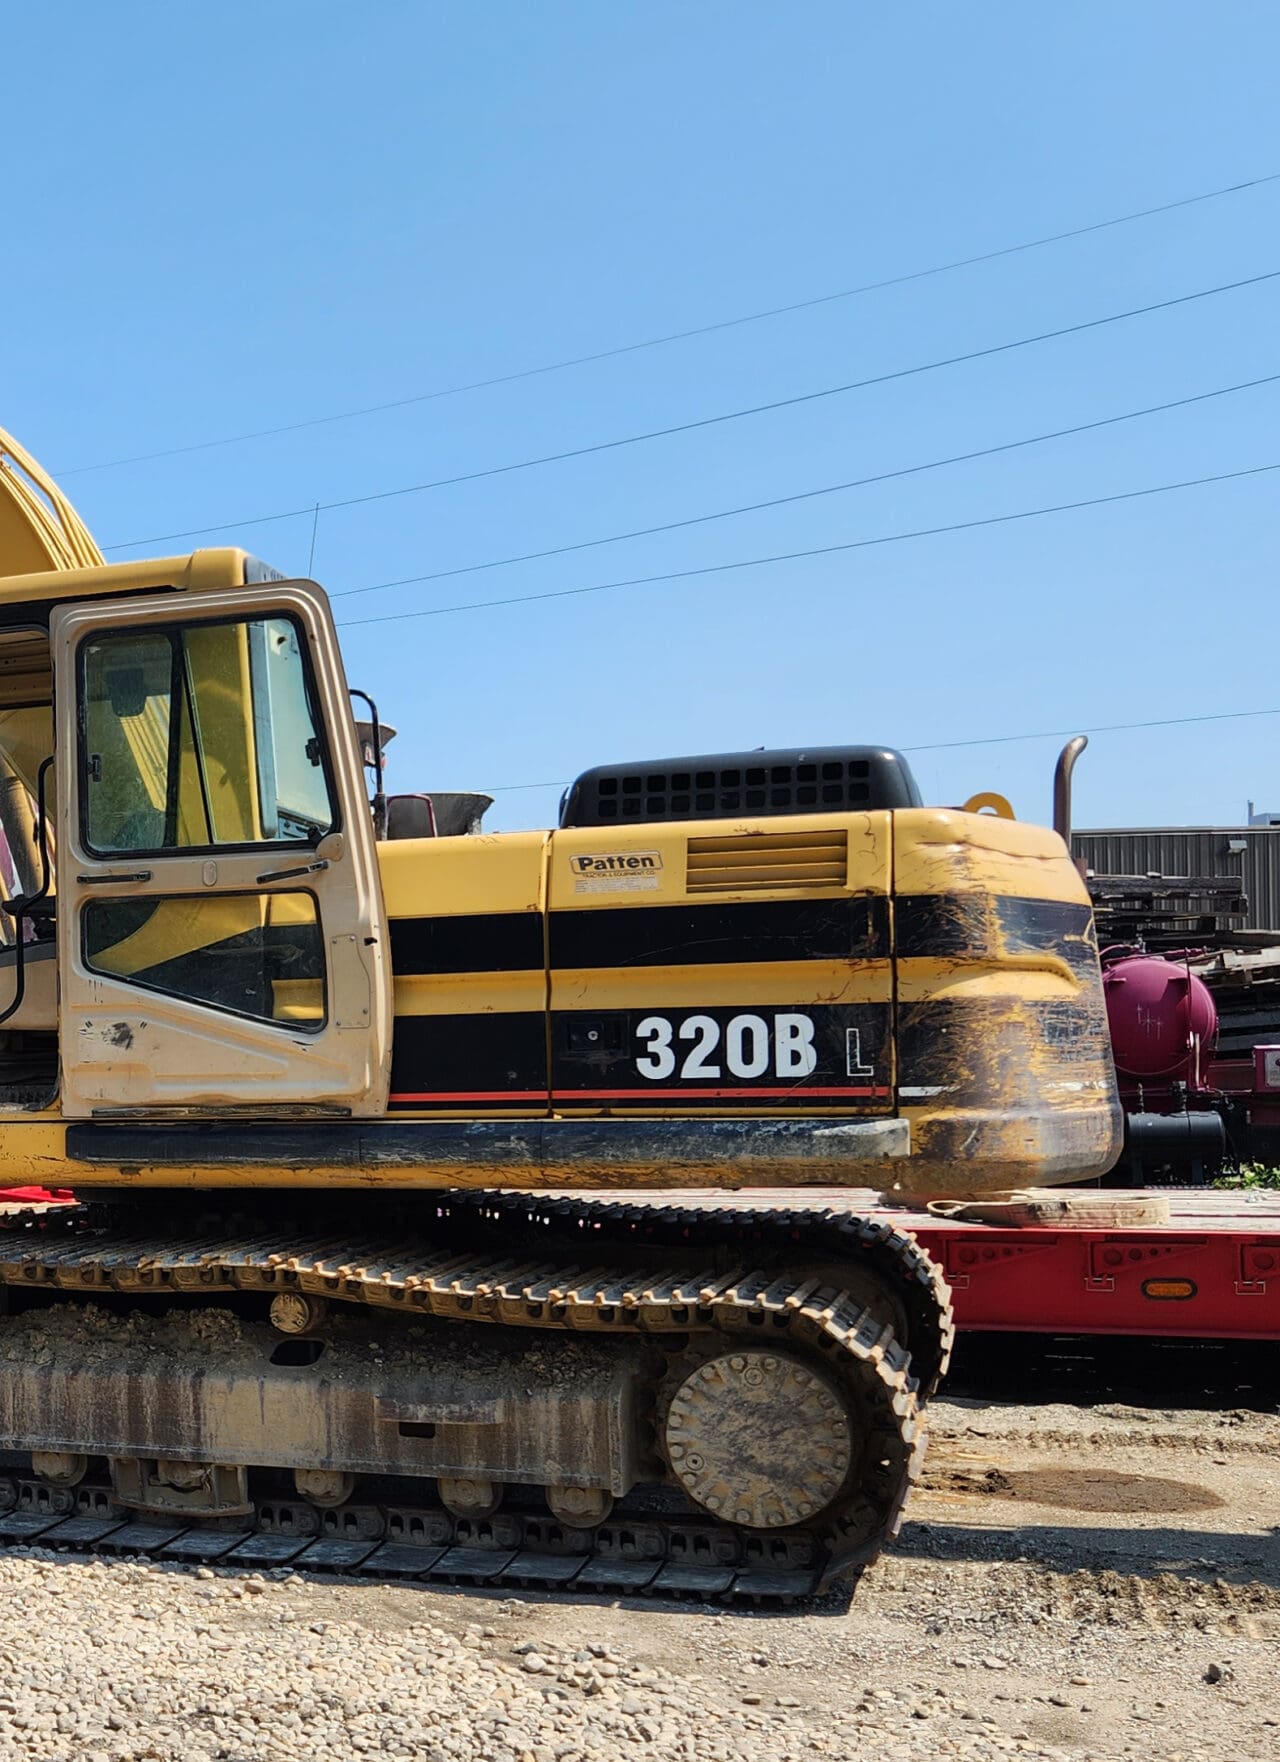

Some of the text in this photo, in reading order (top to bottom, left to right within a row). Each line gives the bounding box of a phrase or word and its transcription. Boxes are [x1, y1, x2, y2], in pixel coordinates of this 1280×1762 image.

[577, 856, 655, 871] Patten
[635, 1013, 874, 1080] 320B L
